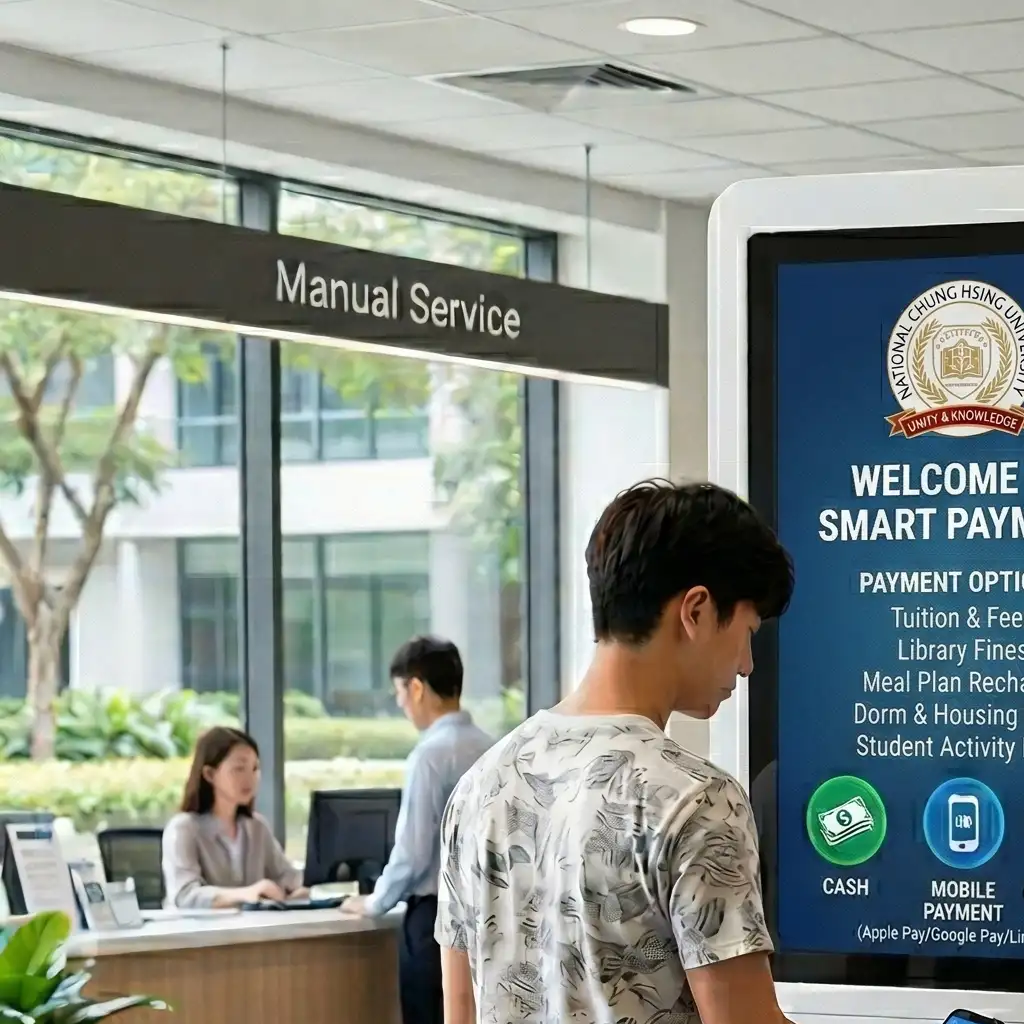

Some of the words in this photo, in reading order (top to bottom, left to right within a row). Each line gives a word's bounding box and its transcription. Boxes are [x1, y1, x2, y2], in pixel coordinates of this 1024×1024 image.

[277, 260, 398, 318] Manual
[410, 283, 520, 338] Service
[891, 325, 913, 400] NATIONAL
[909, 286, 957, 321] CHUNG
[962, 285, 1007, 310] HSING
[942, 412, 949, 422] &
[951, 410, 1018, 429] KNOWLEDGE
[851, 462, 1018, 496] WELCOME
[819, 508, 936, 541] SMART
[860, 571, 962, 593] PAYMENT
[891, 607, 959, 628] Tuition
[967, 606, 980, 628] &
[899, 638, 967, 666] Library
[864, 671, 909, 692] Meal
[919, 671, 960, 692] Plan
[855, 703, 906, 724] Dorm
[914, 703, 927, 724] &
[935, 703, 1017, 731] Housing
[857, 734, 933, 757] Student
[940, 736, 1015, 763] Activity
[823, 878, 868, 895] CASH
[932, 881, 995, 898] MOBILE
[924, 903, 1003, 921] PAYMENT
[858, 924, 898, 942] (Apple
[903, 926, 976, 945] Pay/Google
